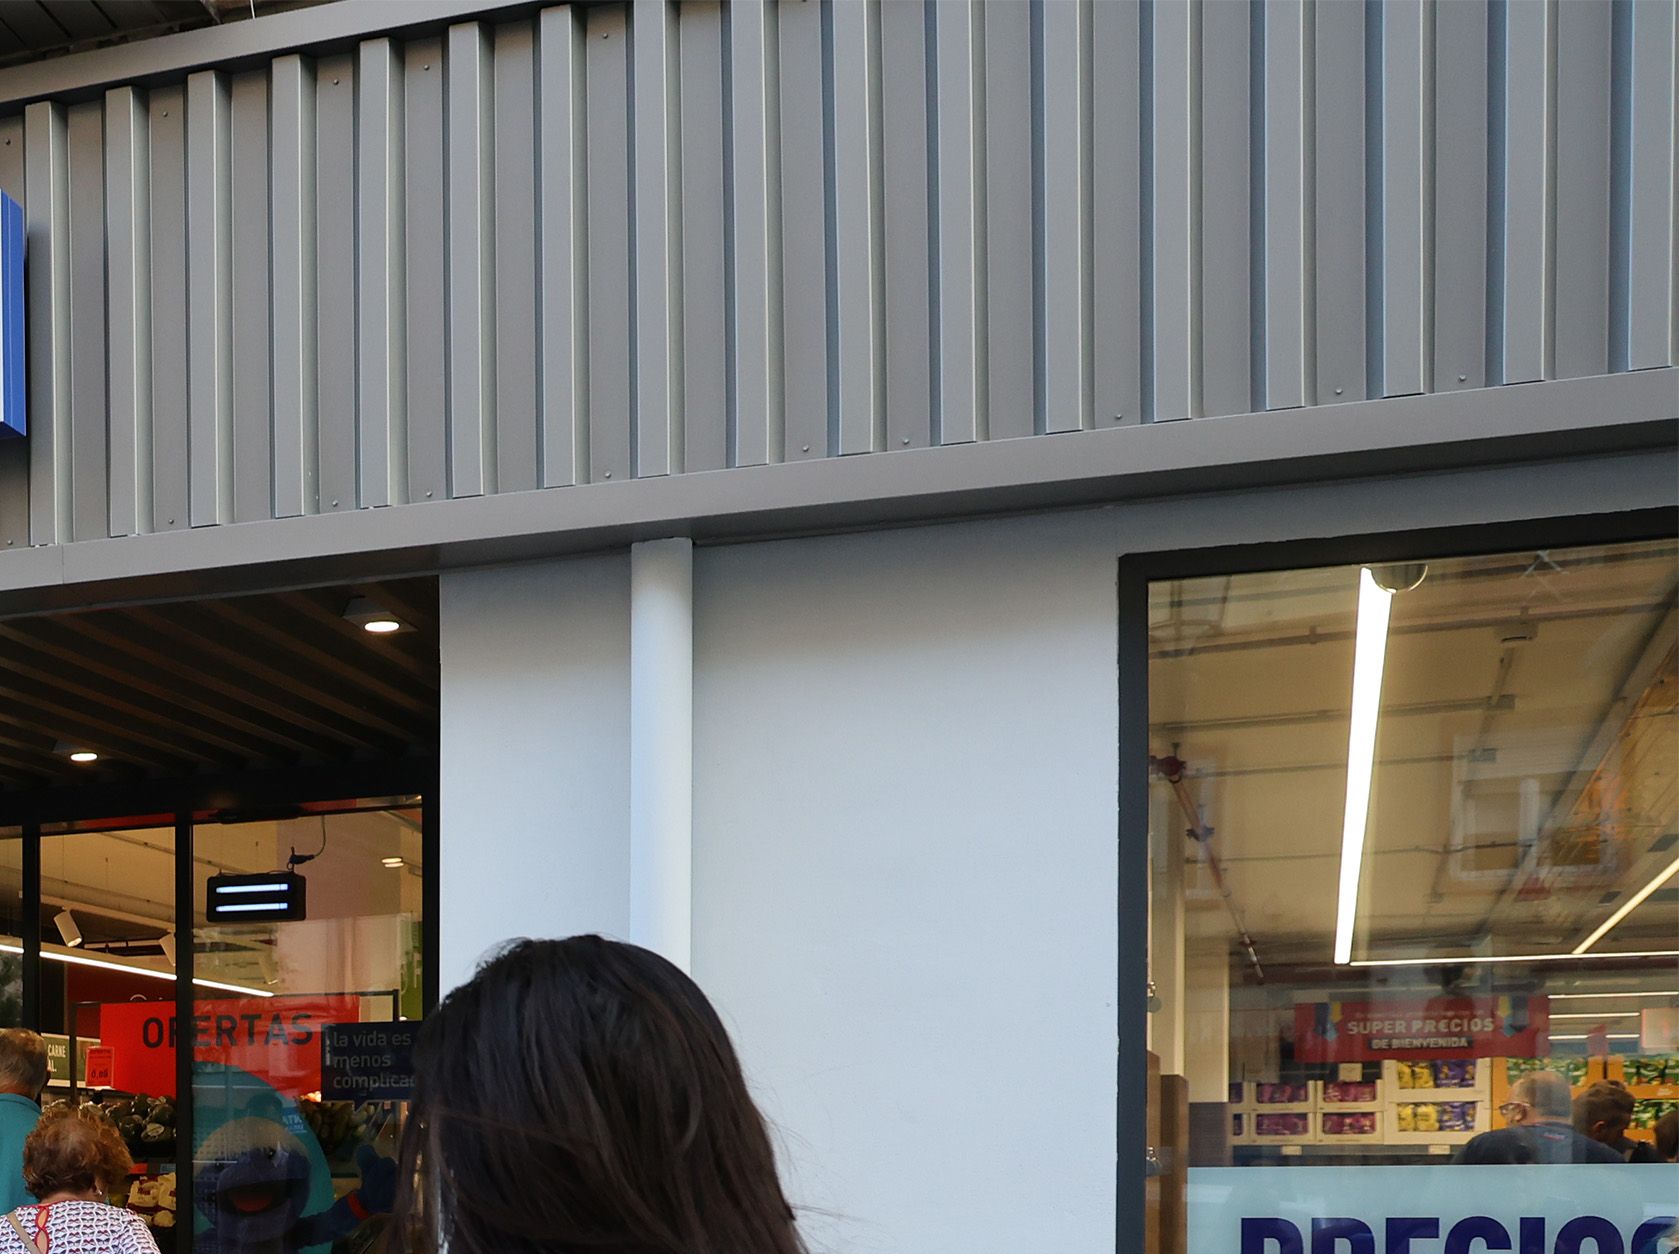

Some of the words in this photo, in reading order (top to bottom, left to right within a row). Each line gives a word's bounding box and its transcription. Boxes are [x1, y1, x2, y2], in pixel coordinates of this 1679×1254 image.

[1348, 1020, 1407, 1035] SUPER
[1411, 1017, 1495, 1034] PRECIOS
[333, 1032, 348, 1047] la
[353, 1030, 387, 1047] vida
[392, 1032, 412, 1046] es
[1372, 1038, 1389, 1049] DE
[1392, 1036, 1469, 1049] BIENVENIDA
[333, 1054, 392, 1068] menos
